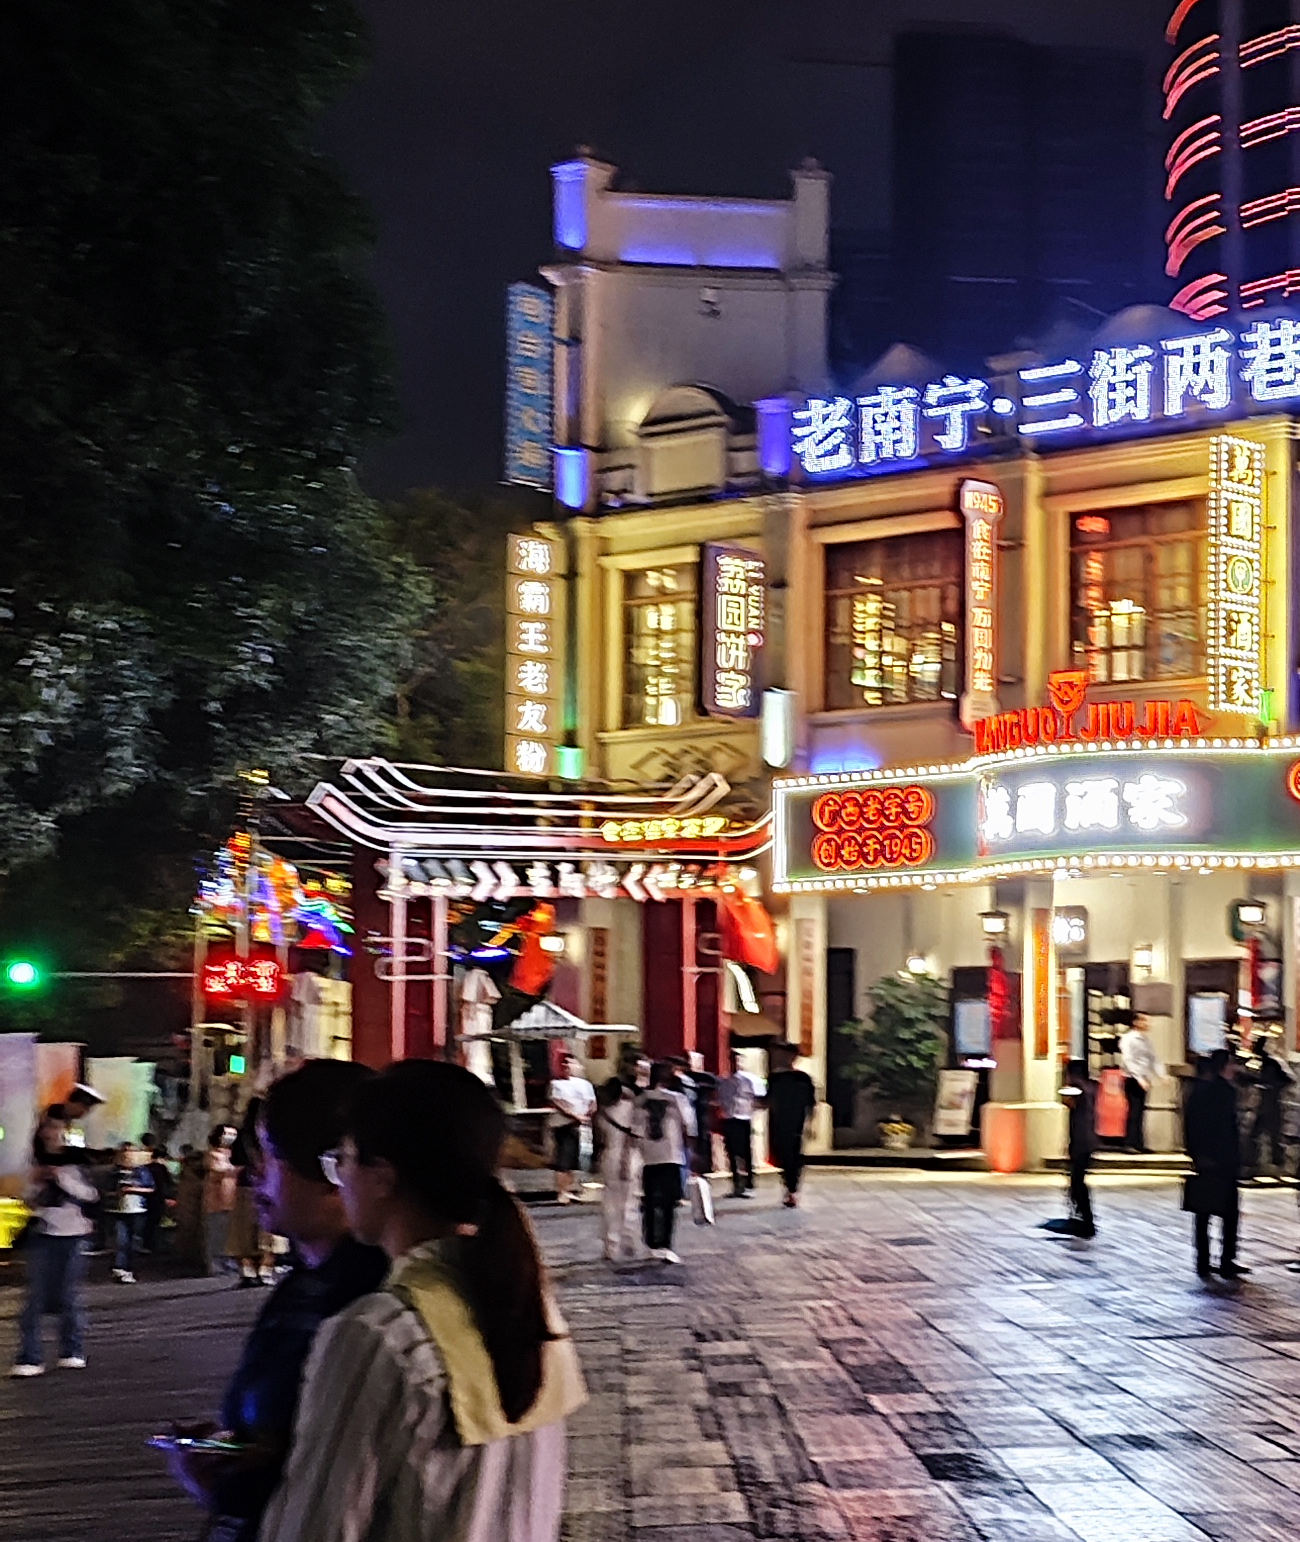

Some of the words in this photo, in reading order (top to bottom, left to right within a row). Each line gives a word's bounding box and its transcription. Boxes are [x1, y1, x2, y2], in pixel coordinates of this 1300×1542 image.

[516, 541, 550, 773] 海霸王老友粉
[1080, 698, 1201, 740] JIUJIA
[818, 789, 924, 825] 广西老字号
[819, 836, 923, 864] 创始于1945
